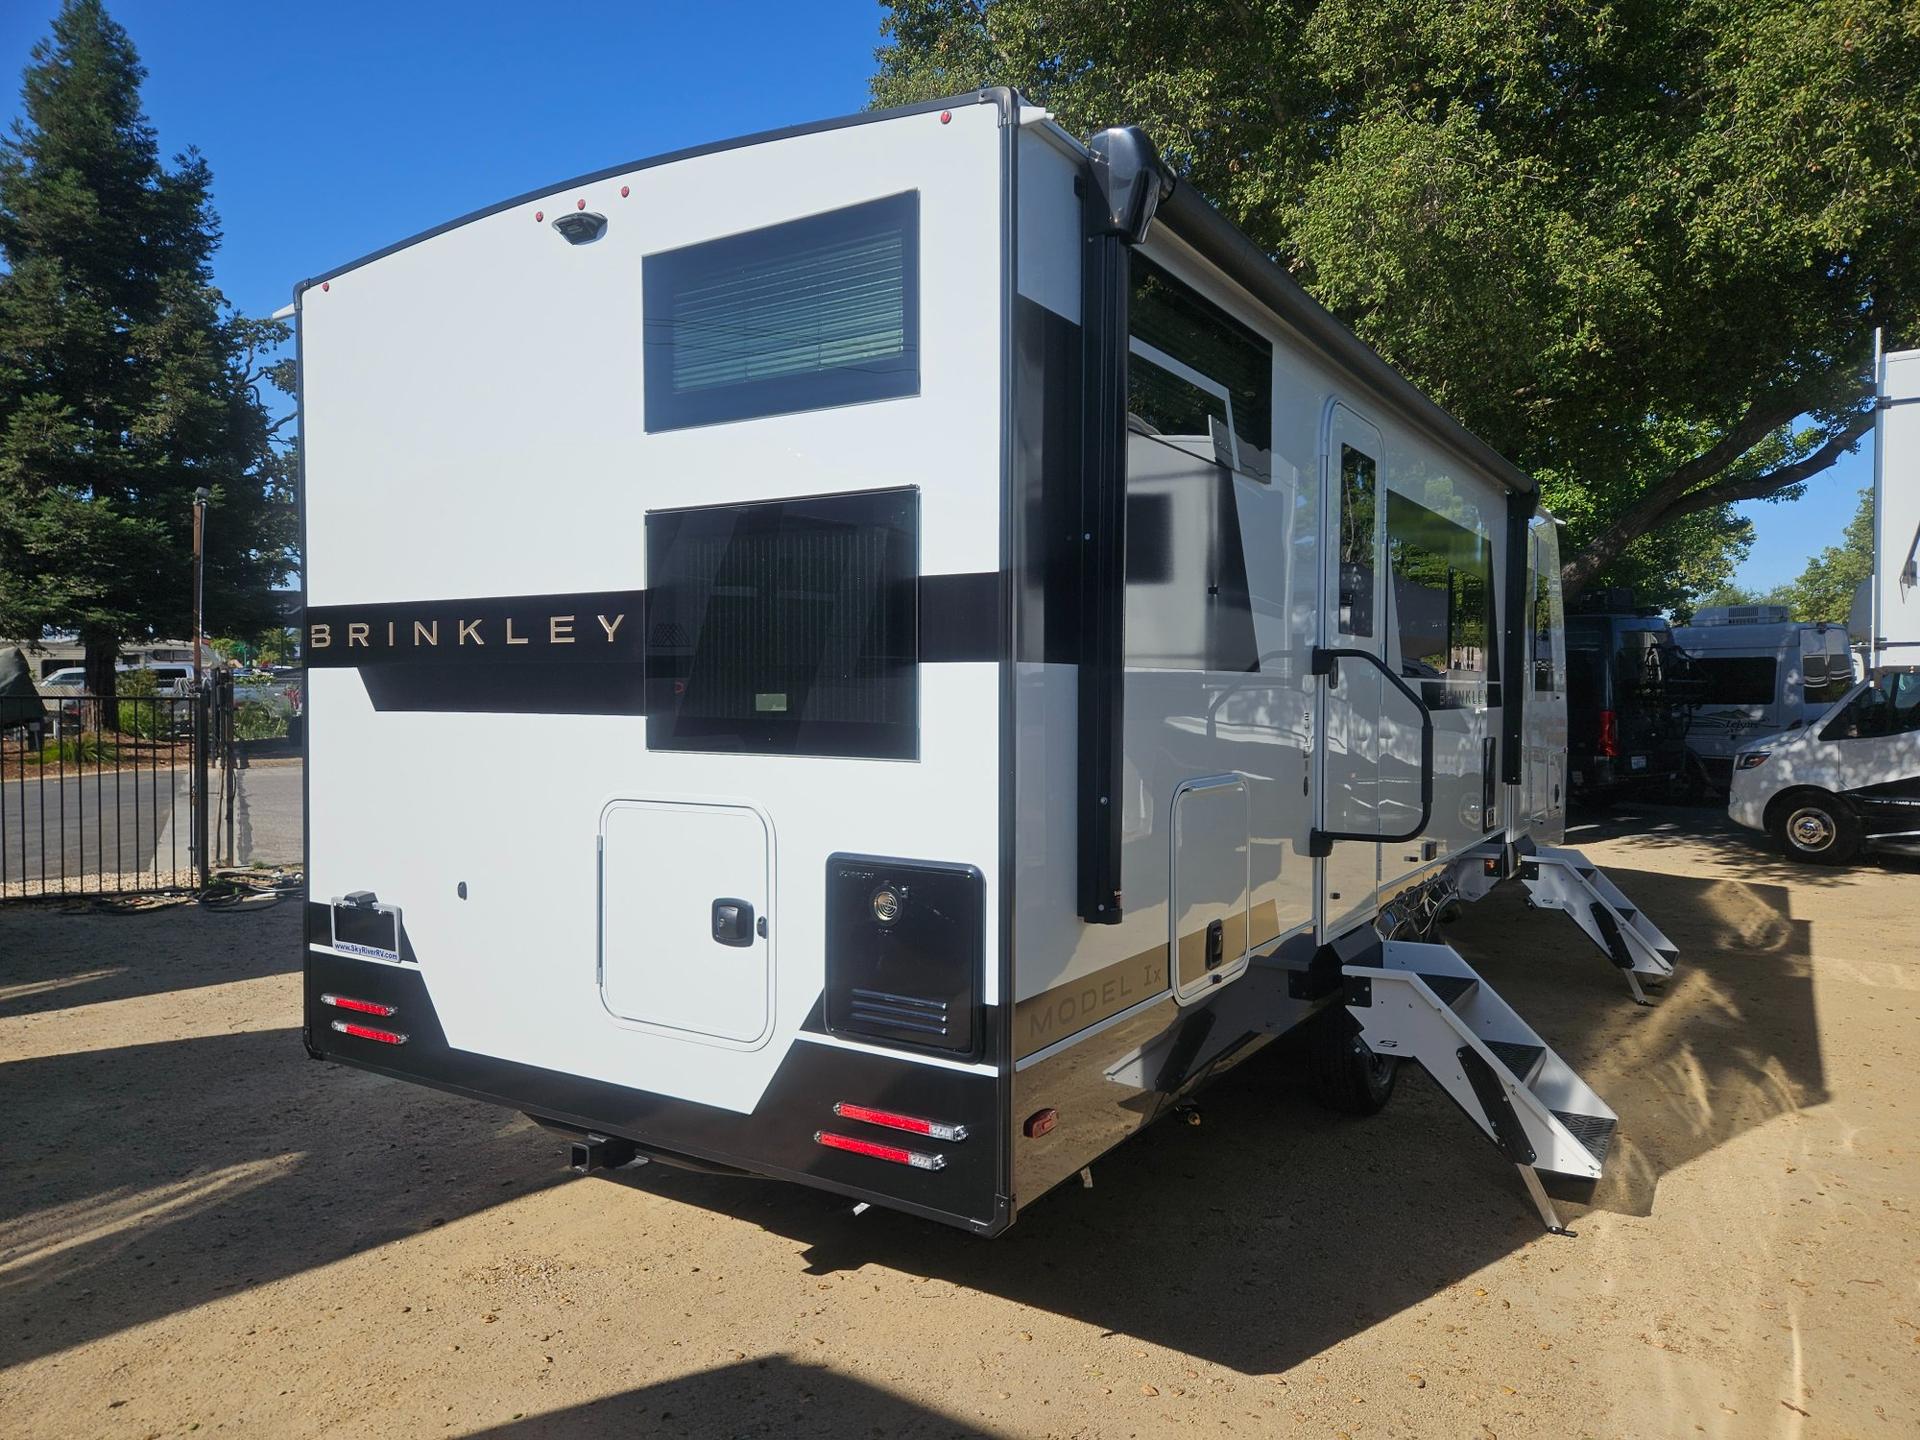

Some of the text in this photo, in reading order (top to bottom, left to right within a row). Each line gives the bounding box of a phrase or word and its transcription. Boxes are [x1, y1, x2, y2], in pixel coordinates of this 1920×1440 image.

[310, 613, 625, 648] BRINKLEY
[334, 942, 398, 960] www.SkyRiverRV.com
[1029, 975, 1133, 1037] MODEL
